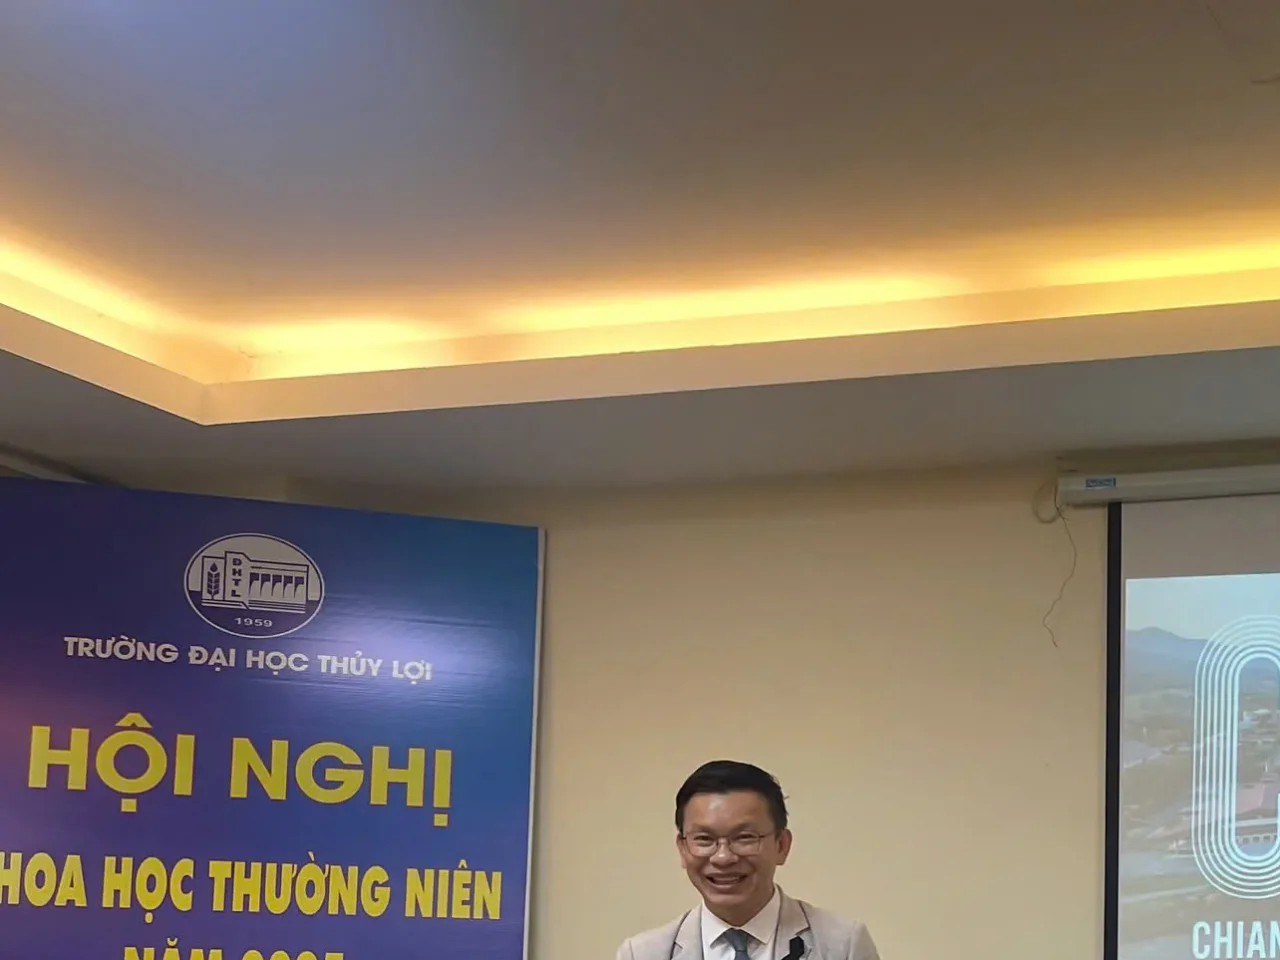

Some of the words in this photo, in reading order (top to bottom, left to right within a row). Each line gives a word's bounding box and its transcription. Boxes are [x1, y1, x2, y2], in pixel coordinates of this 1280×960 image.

[235, 617, 273, 628] 1959
[64, 635, 179, 663] TRƯỜNG
[188, 645, 236, 672] ĐẠI
[246, 650, 309, 676] HỌC
[318, 650, 383, 677] THỦY
[392, 659, 433, 685] LỢI
[28, 712, 195, 813] HỘI
[230, 738, 453, 828] NGHỊ
[102, 856, 194, 923] HỌC
[208, 851, 391, 917] THƯỜNG
[405, 859, 502, 920] NIÊN
